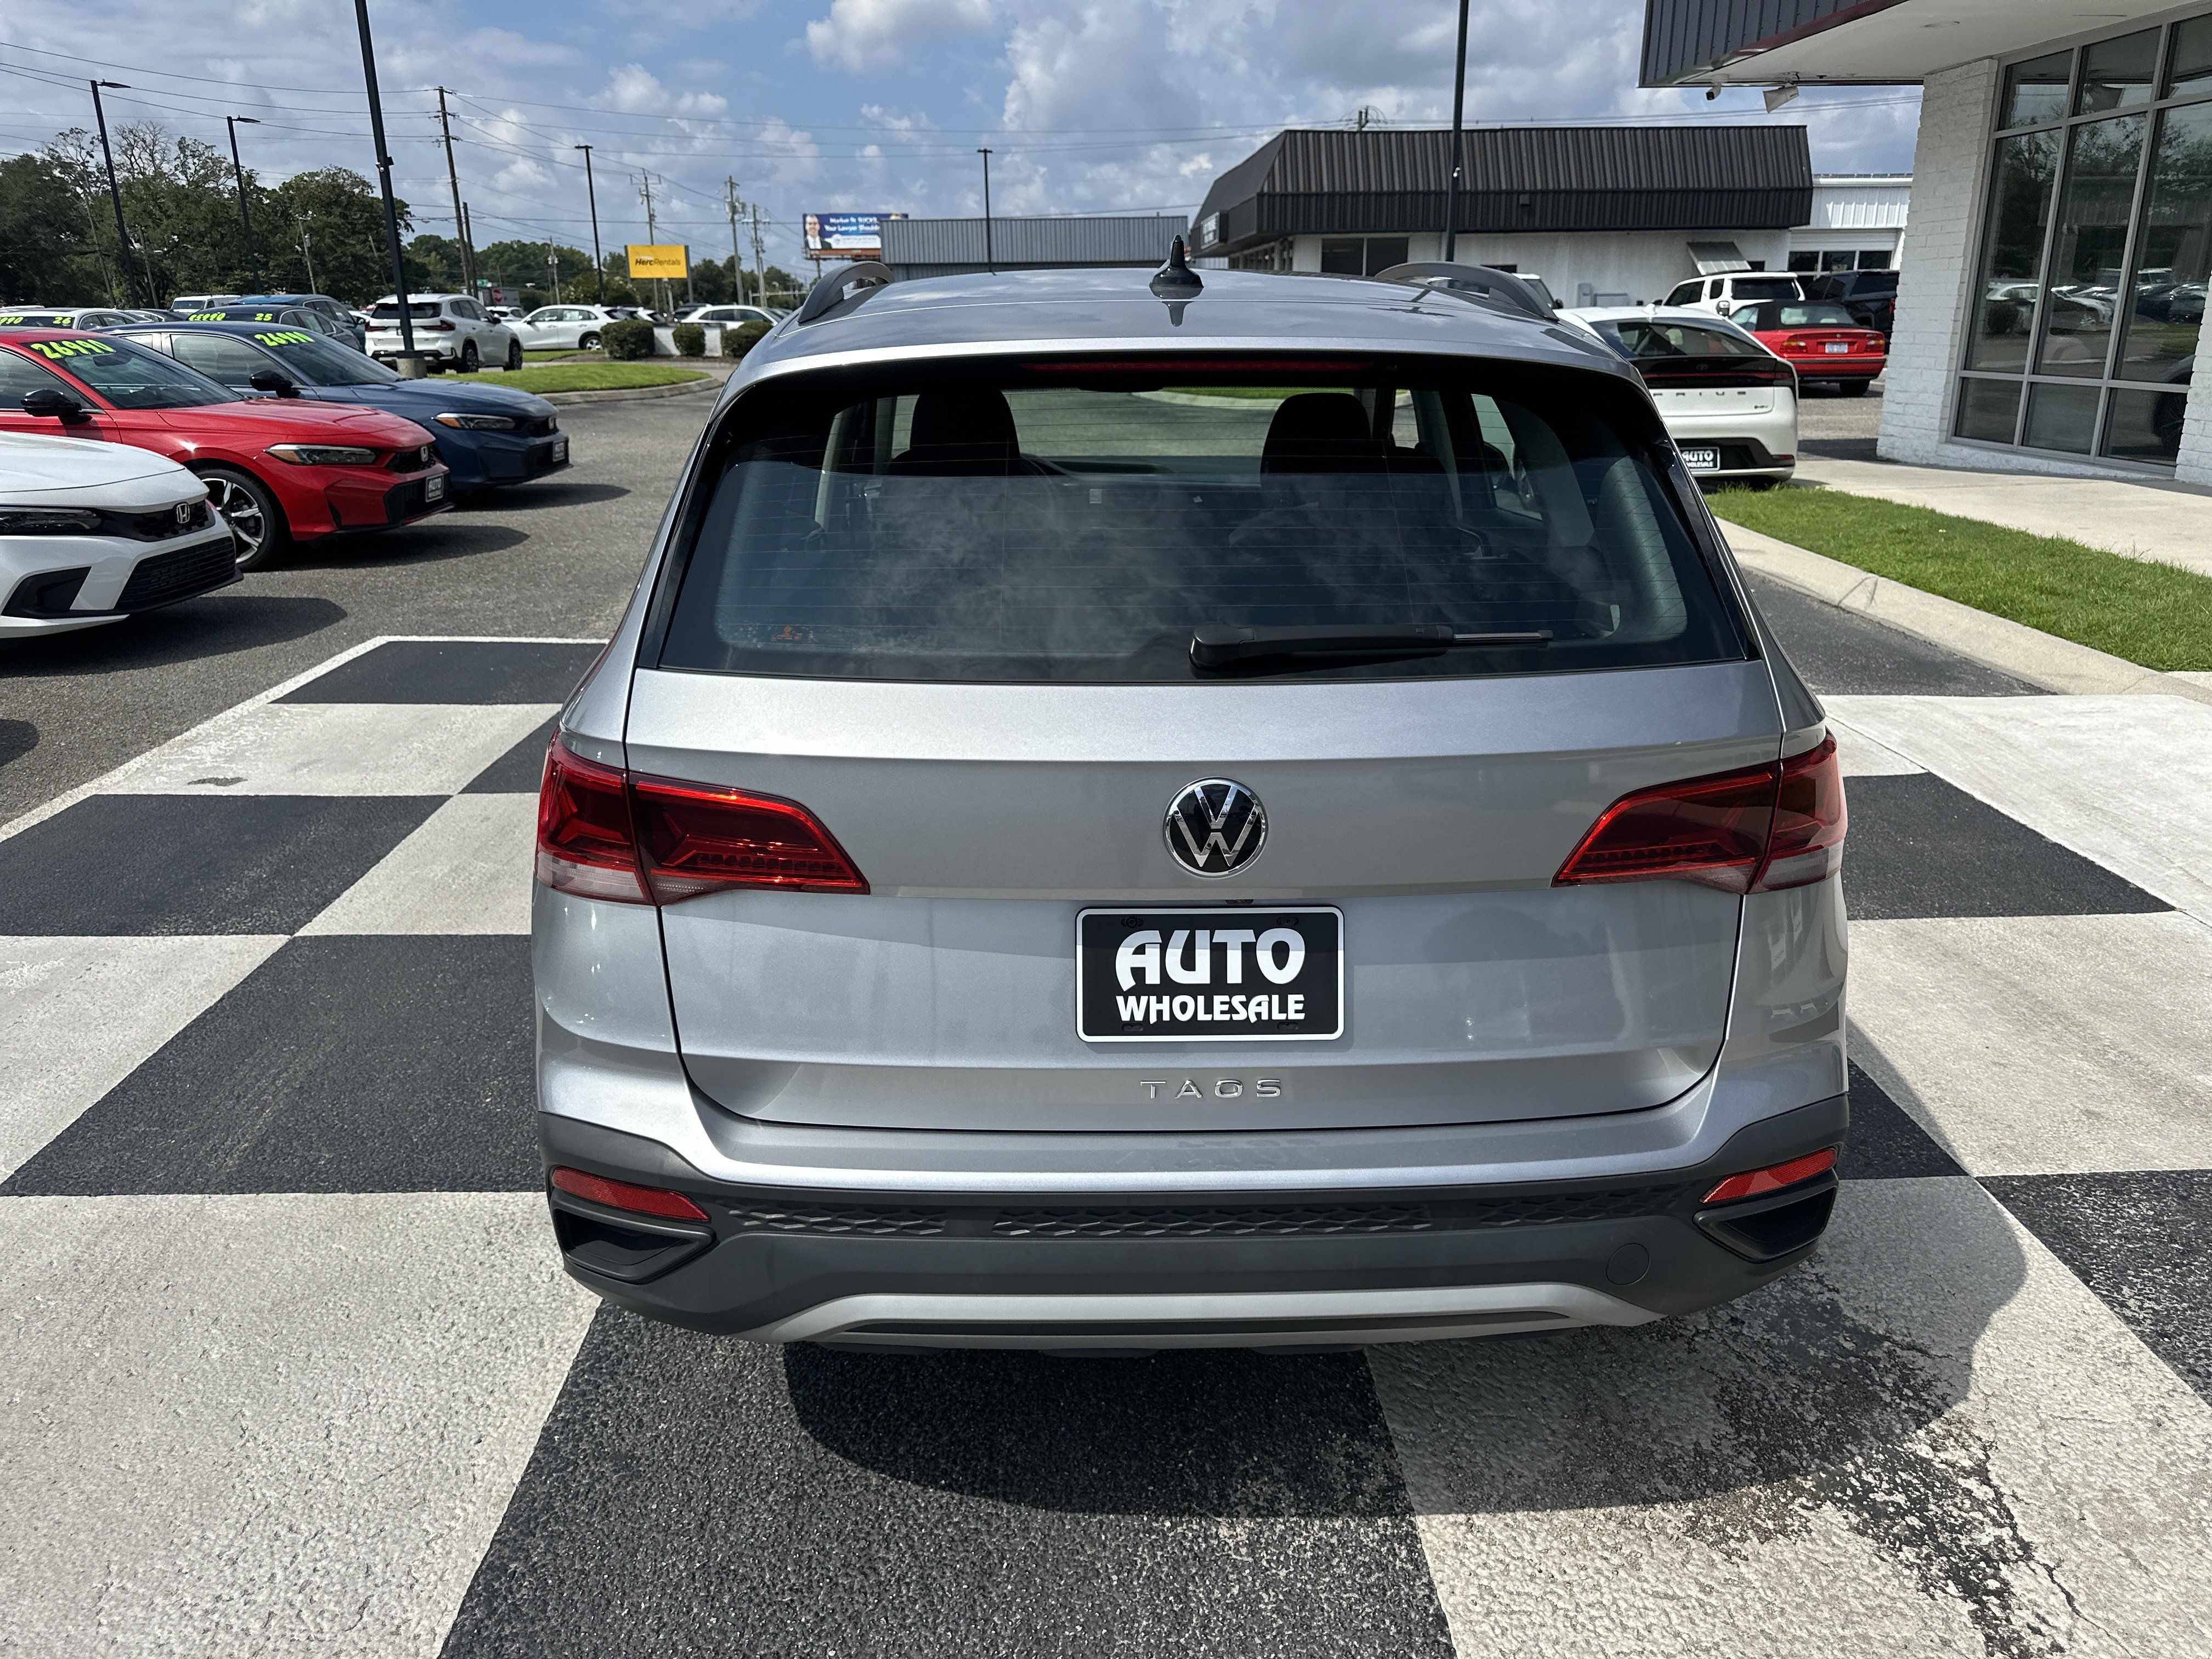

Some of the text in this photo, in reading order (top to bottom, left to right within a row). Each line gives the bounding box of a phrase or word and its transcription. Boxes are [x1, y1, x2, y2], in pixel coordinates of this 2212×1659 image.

[0, 317, 24, 325] 990
[255, 331, 314, 346] 26990
[30, 339, 116, 359] 26990
[1681, 450, 1714, 461] AUTO
[1115, 928, 1306, 991] AUTO
[1115, 994, 1306, 1024] WHOLESALE
[1140, 1079, 1282, 1099] TAOS
